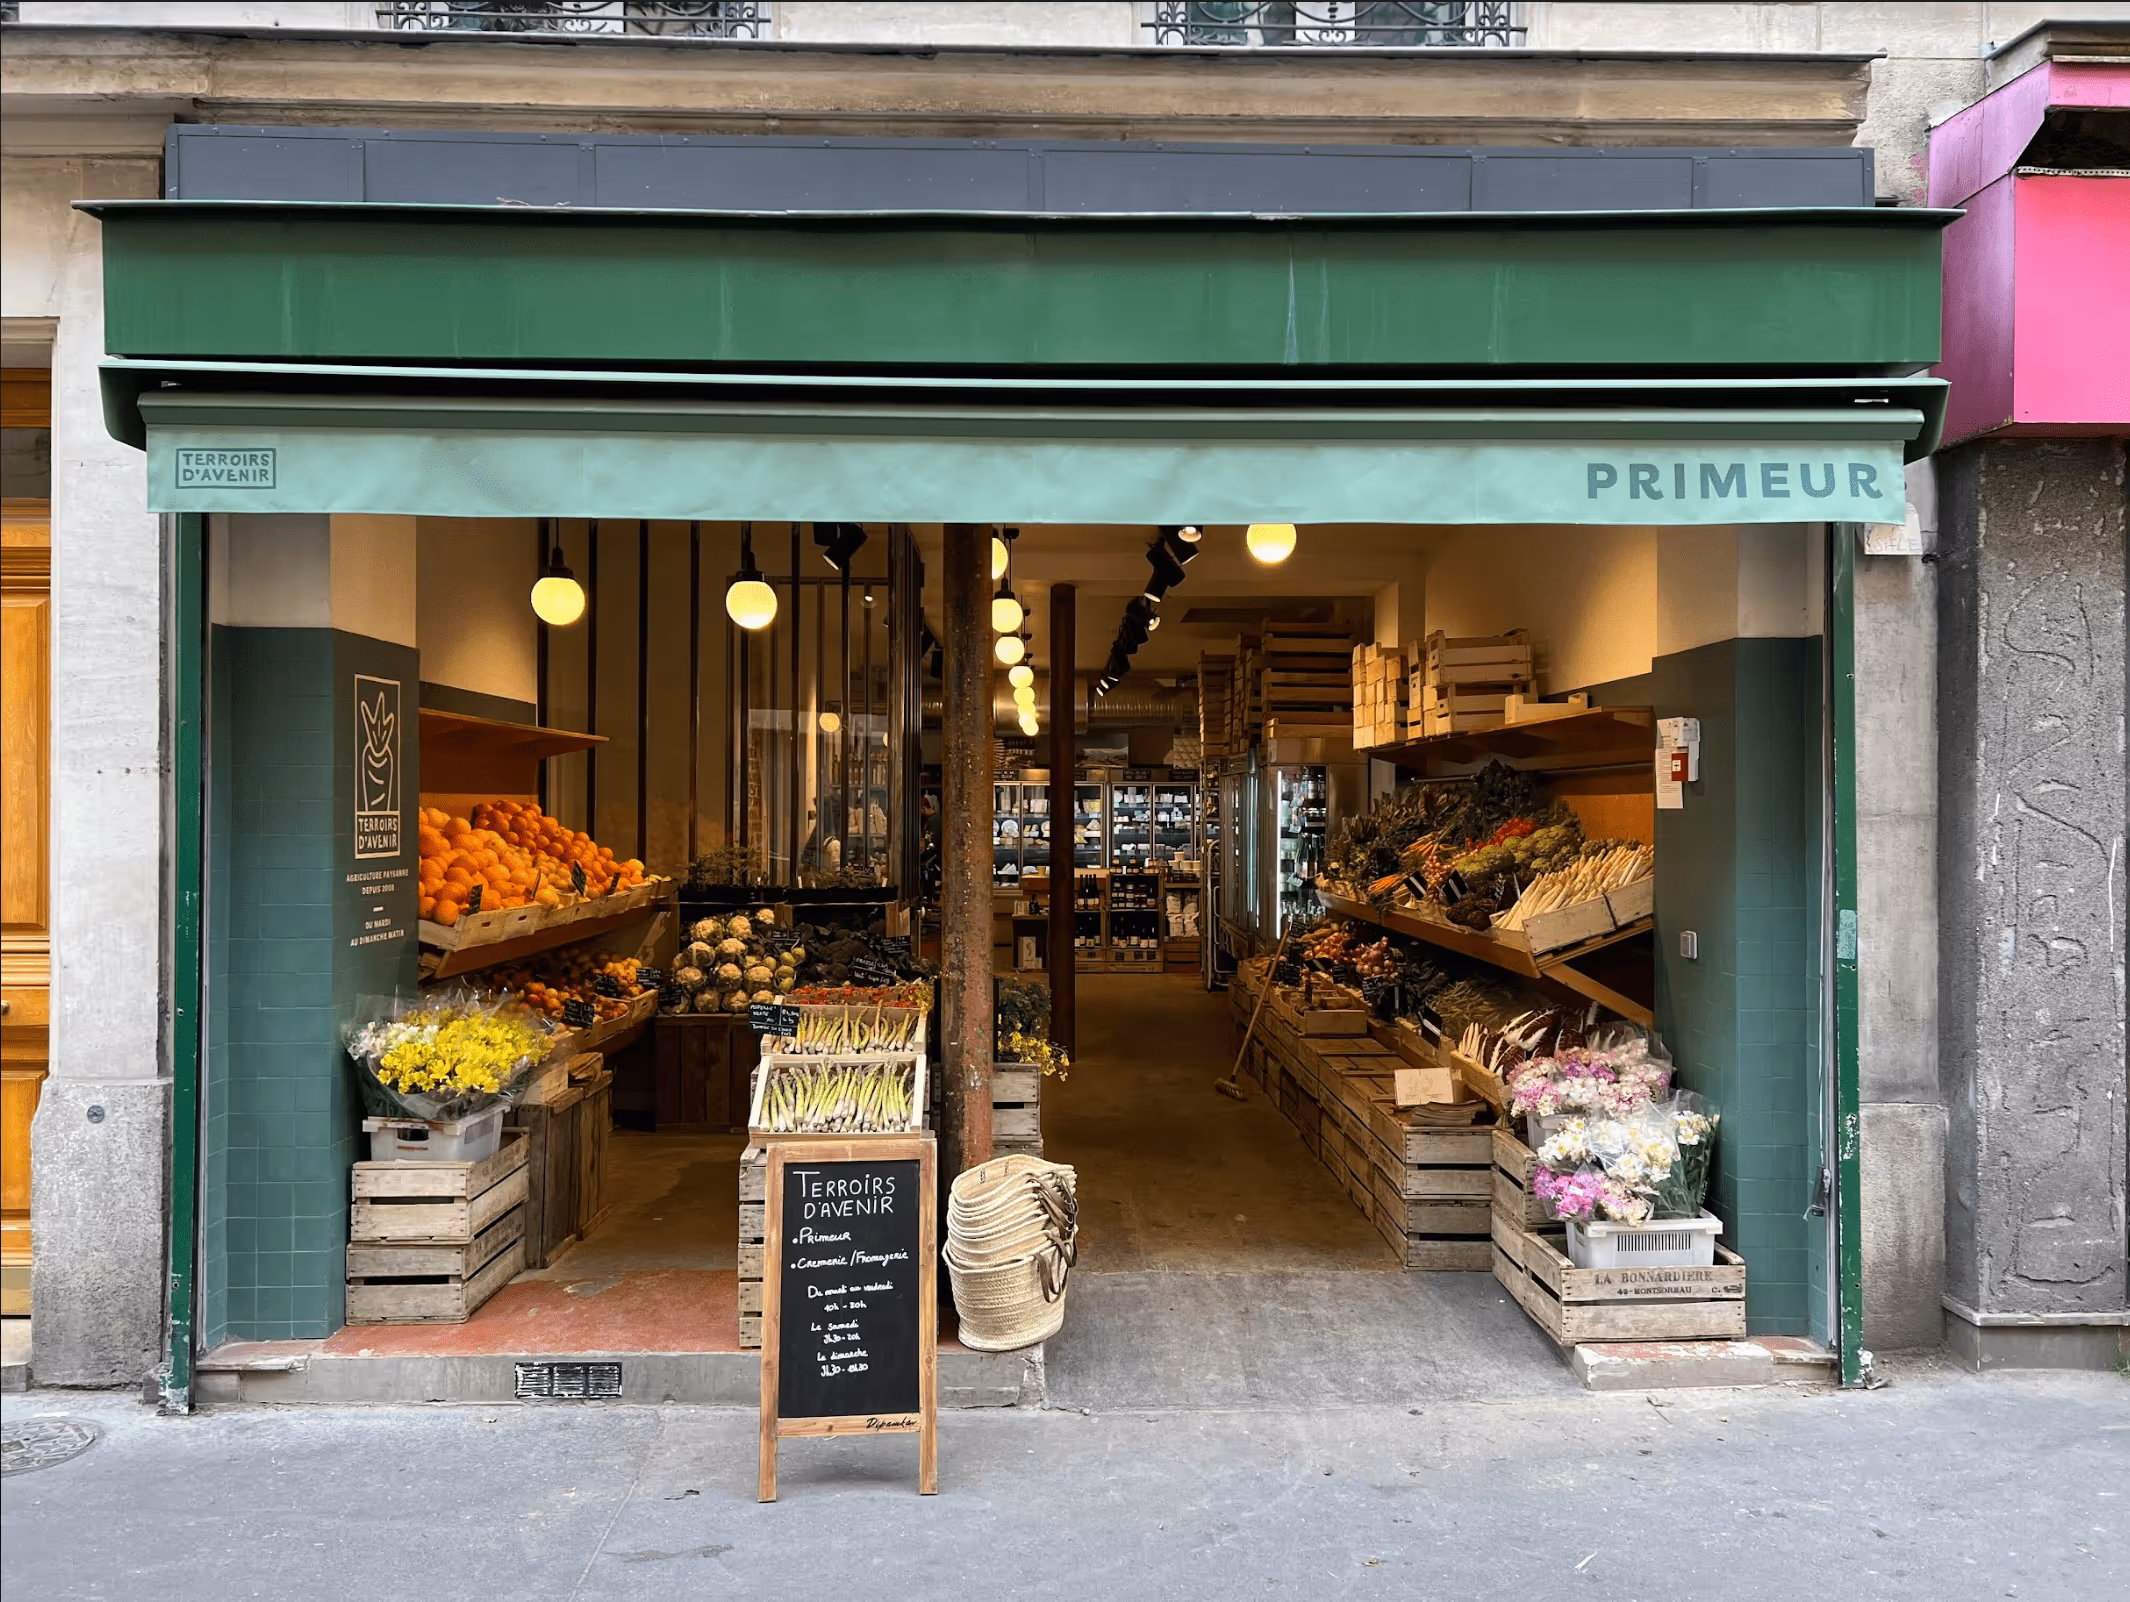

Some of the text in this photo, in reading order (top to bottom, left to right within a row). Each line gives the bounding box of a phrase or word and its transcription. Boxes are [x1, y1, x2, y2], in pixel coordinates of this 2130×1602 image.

[182, 453, 270, 466] TERROIRS
[182, 468, 270, 482] D'AVENIR
[1586, 462, 1883, 500] PRIMEUR
[358, 817, 398, 833] TERROIRS
[358, 833, 398, 850] D'AVENIR
[346, 871, 382, 882] AGRICULTURE
[361, 885, 381, 895] DEPUIS
[365, 918, 391, 929] DU MARDI
[350, 929, 405, 947] AU DIMANCHE MATIN
[1594, 1272, 1612, 1285] LA
[810, 1321, 822, 1331] Le
[816, 1351, 827, 1362] Le
